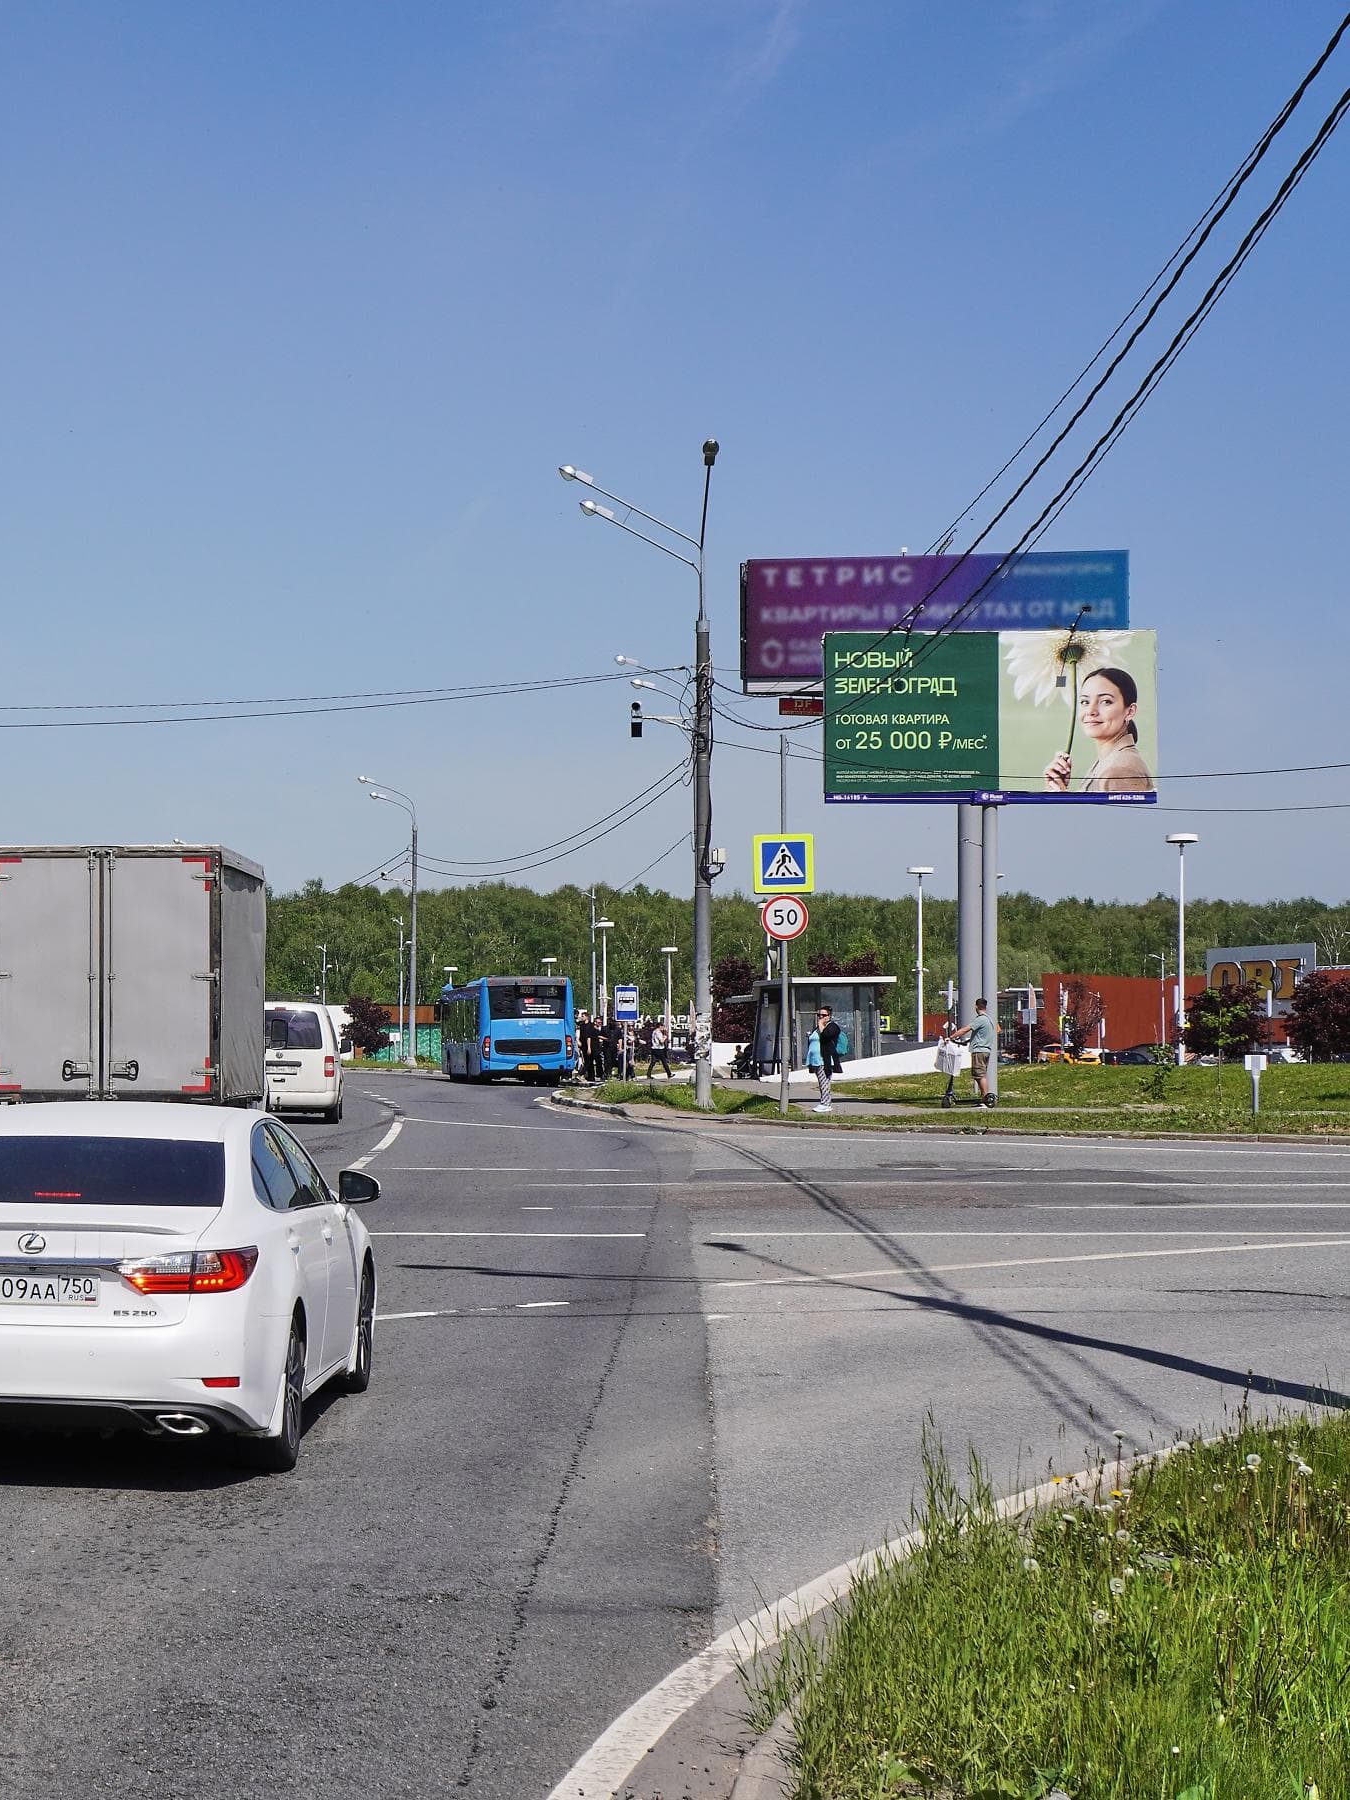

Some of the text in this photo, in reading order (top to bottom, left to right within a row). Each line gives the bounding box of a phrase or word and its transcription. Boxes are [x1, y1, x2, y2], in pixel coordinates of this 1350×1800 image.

[761, 564, 914, 588] ТЕТРИС
[760, 604, 879, 623] КВАРТИРЫ
[834, 648, 913, 669] НОВЫЙ
[834, 677, 958, 697] ЗЕЛЕНОГРАД
[835, 714, 950, 725] ГОТОВАЯ КВАРТИРА
[855, 731, 882, 750] 25
[889, 731, 931, 750] 000
[773, 909, 798, 926] 50
[61, 1278, 93, 1294] 750
